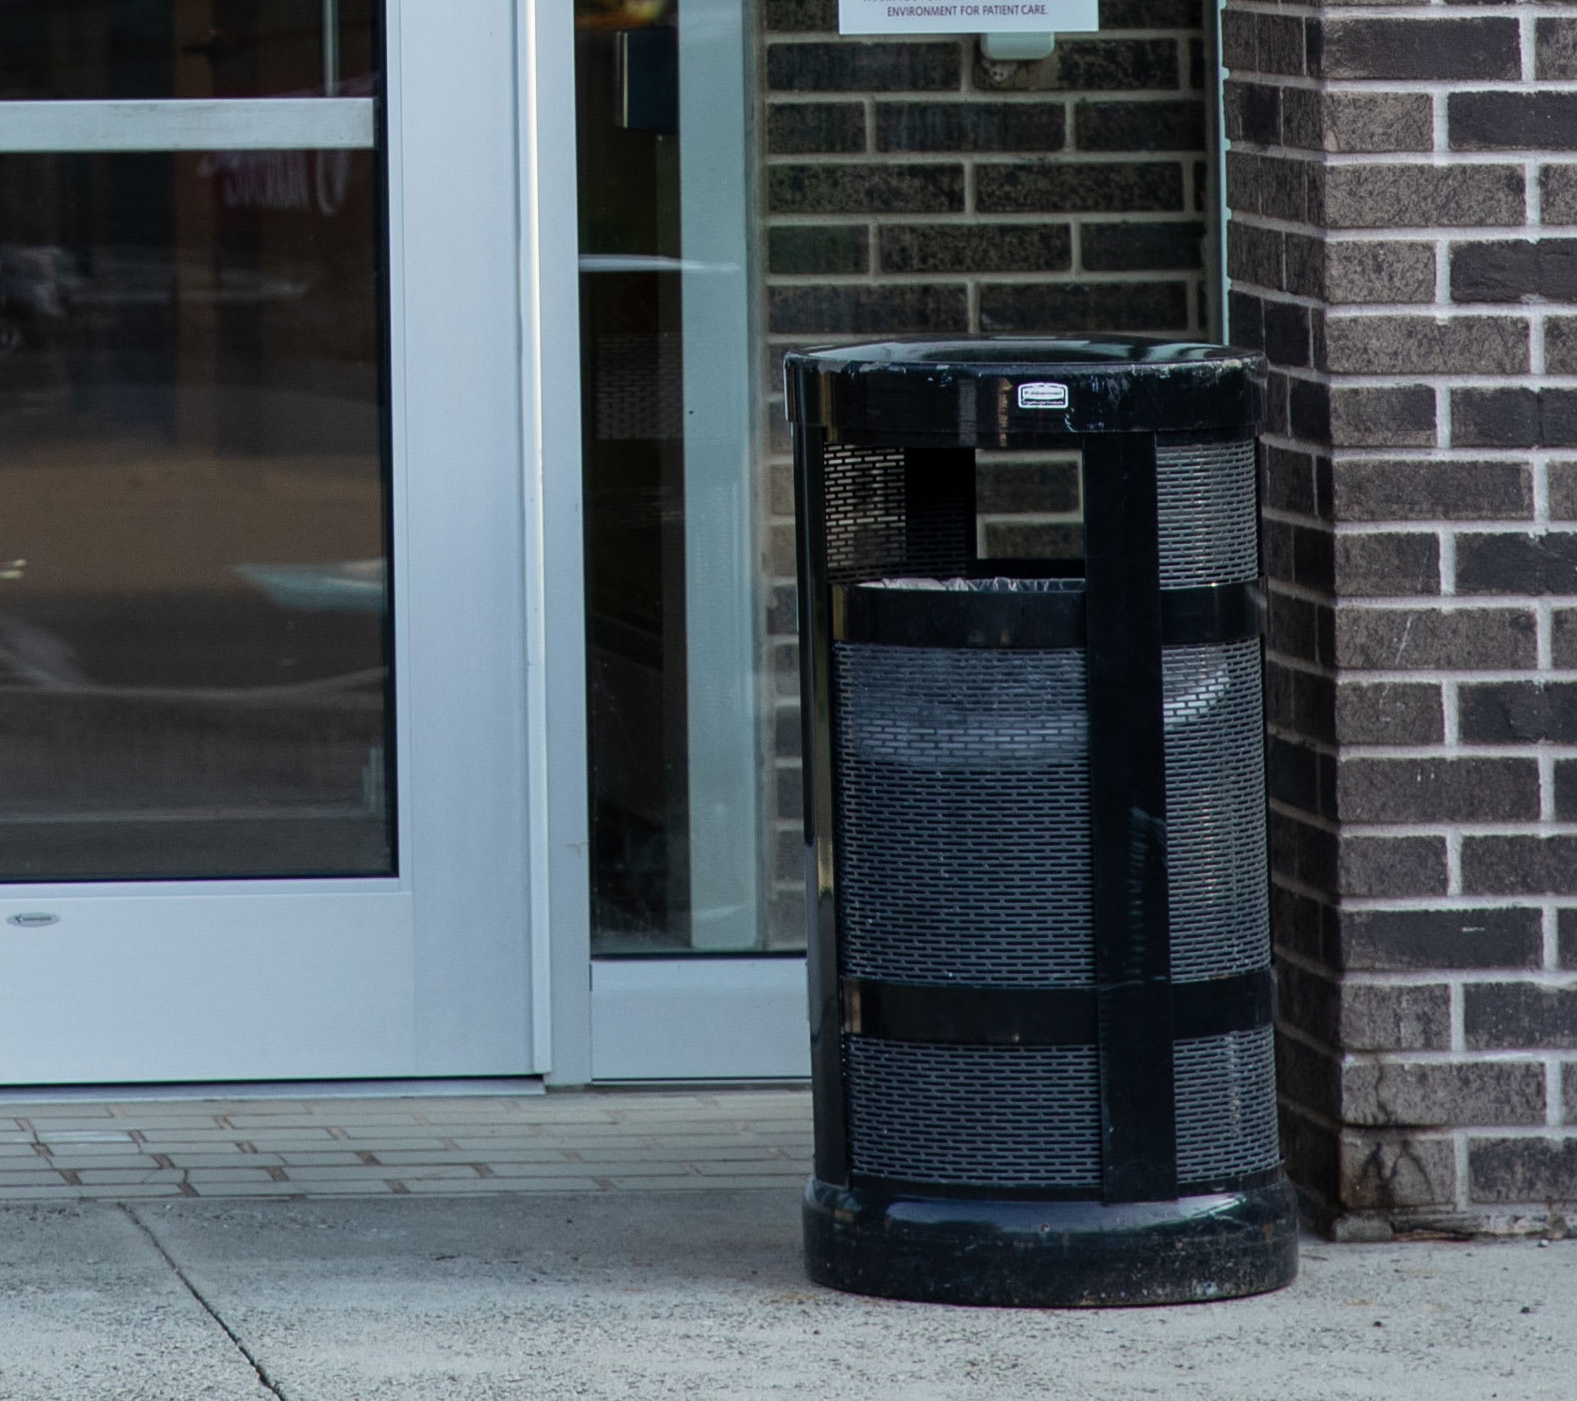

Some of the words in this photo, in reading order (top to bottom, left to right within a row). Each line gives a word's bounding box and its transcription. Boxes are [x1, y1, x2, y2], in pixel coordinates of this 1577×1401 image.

[887, 5, 957, 17] ENVIRONMENT
[960, 5, 980, 16] FOR
[982, 4, 1019, 15] PATIENT
[1021, 4, 1048, 15] CARE.
